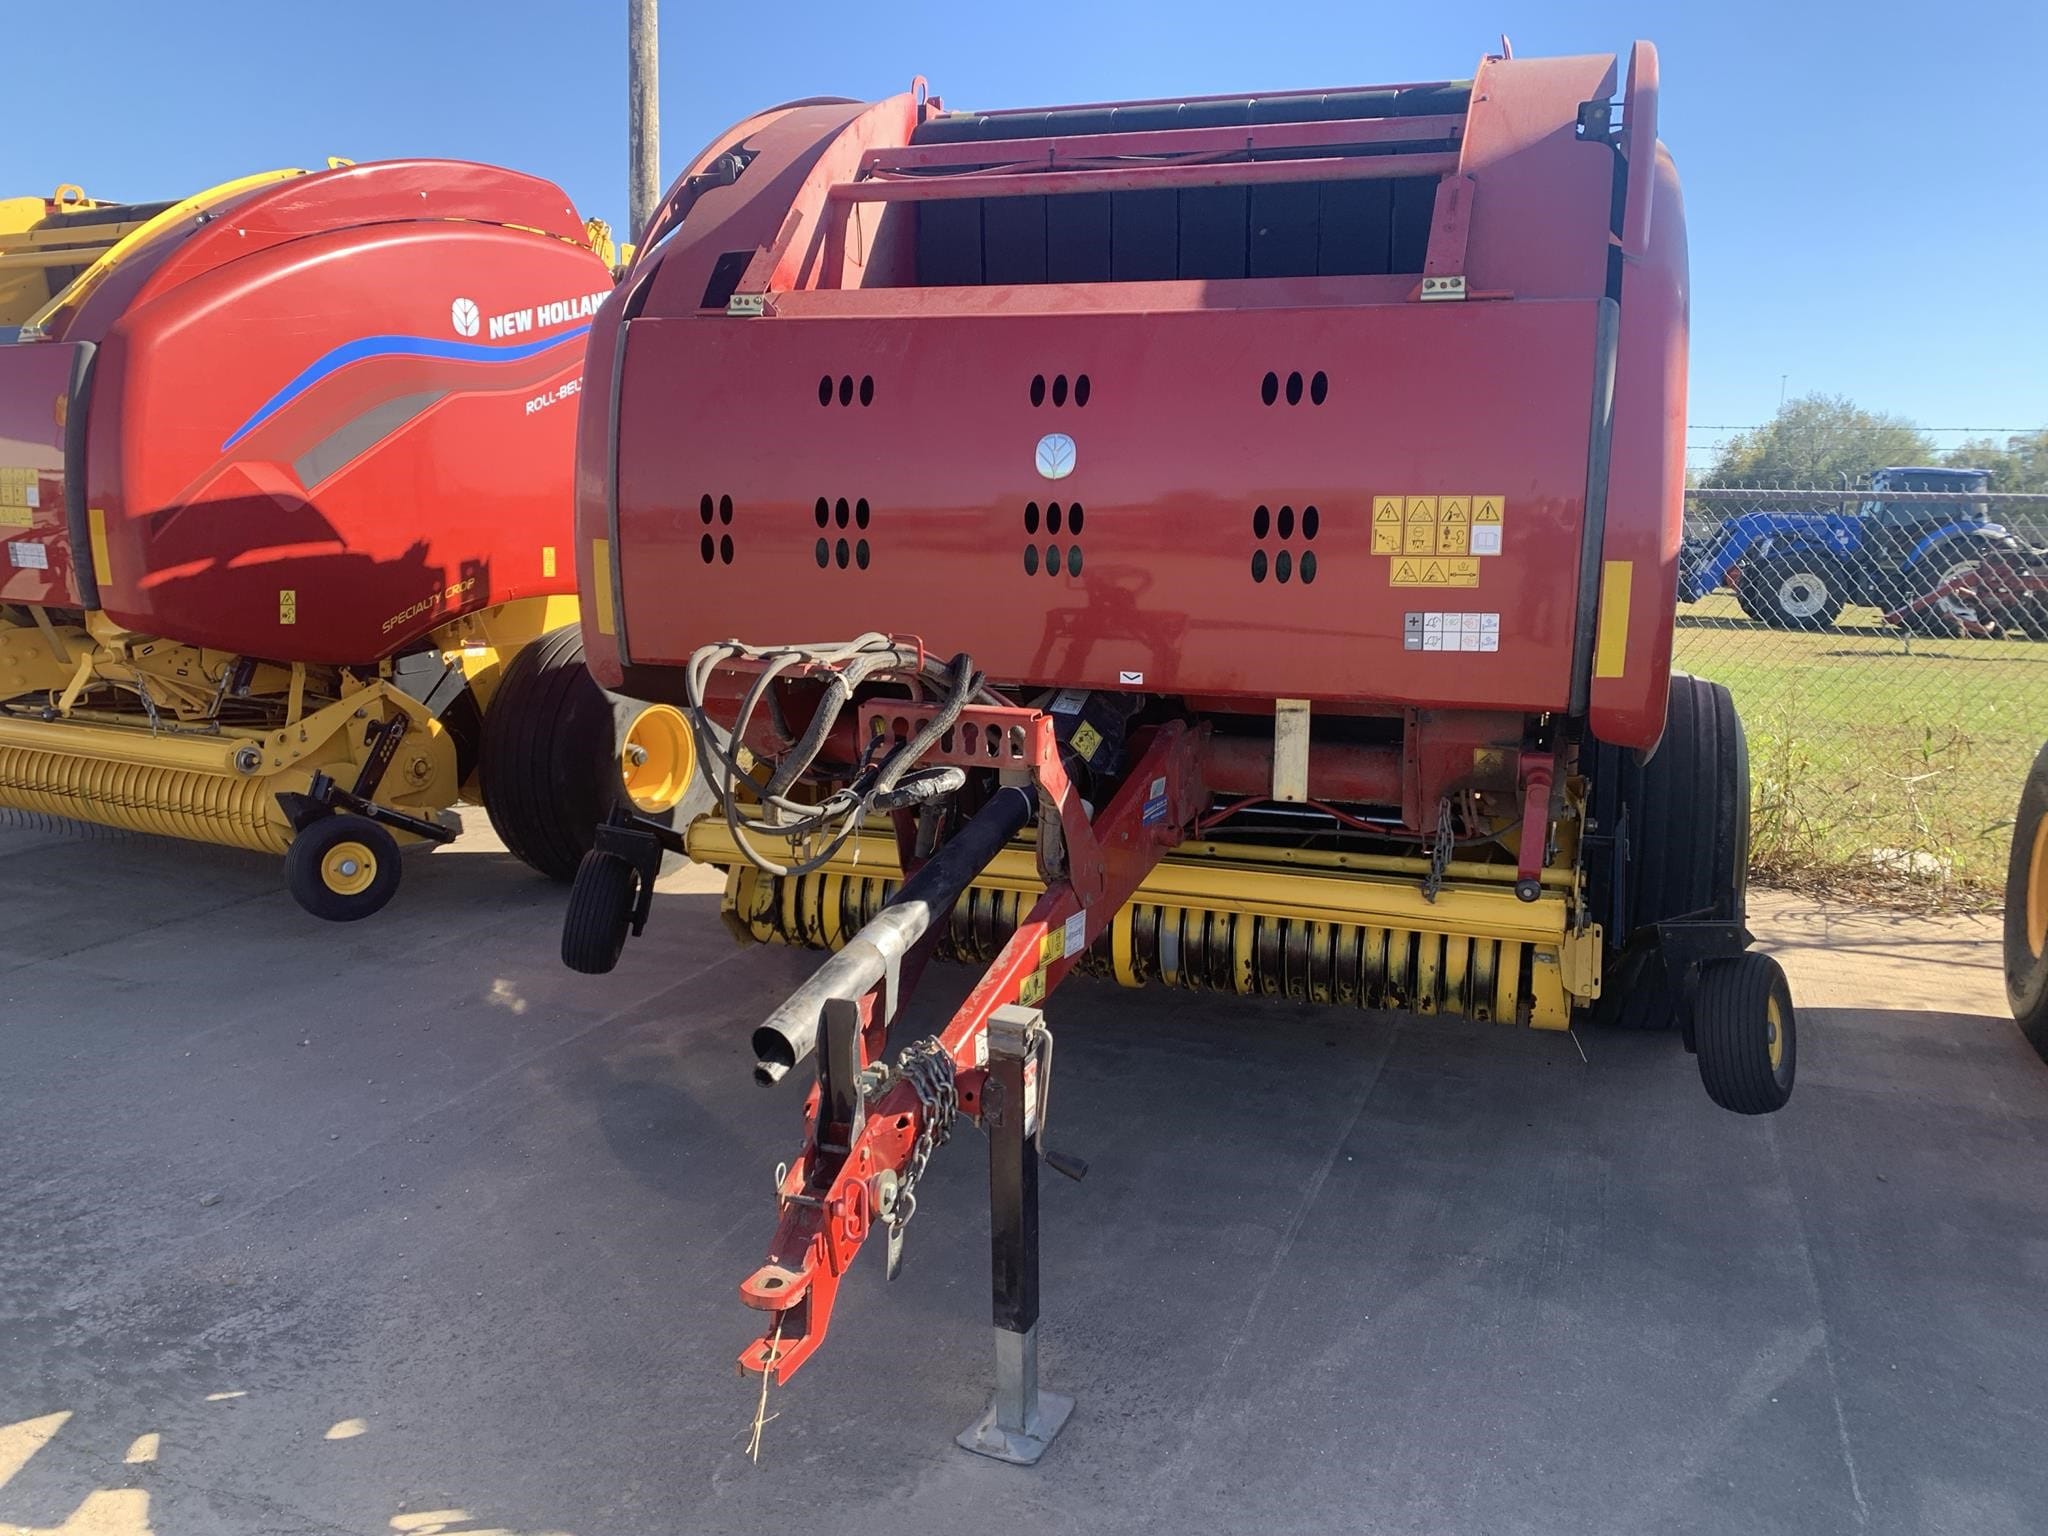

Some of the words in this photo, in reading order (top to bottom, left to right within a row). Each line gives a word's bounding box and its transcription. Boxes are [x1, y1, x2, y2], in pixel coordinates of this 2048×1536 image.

[489, 309, 532, 340] NEW
[537, 290, 613, 328] HOLLAN
[382, 592, 442, 634] SPECIALTY
[445, 578, 475, 599] CROP
